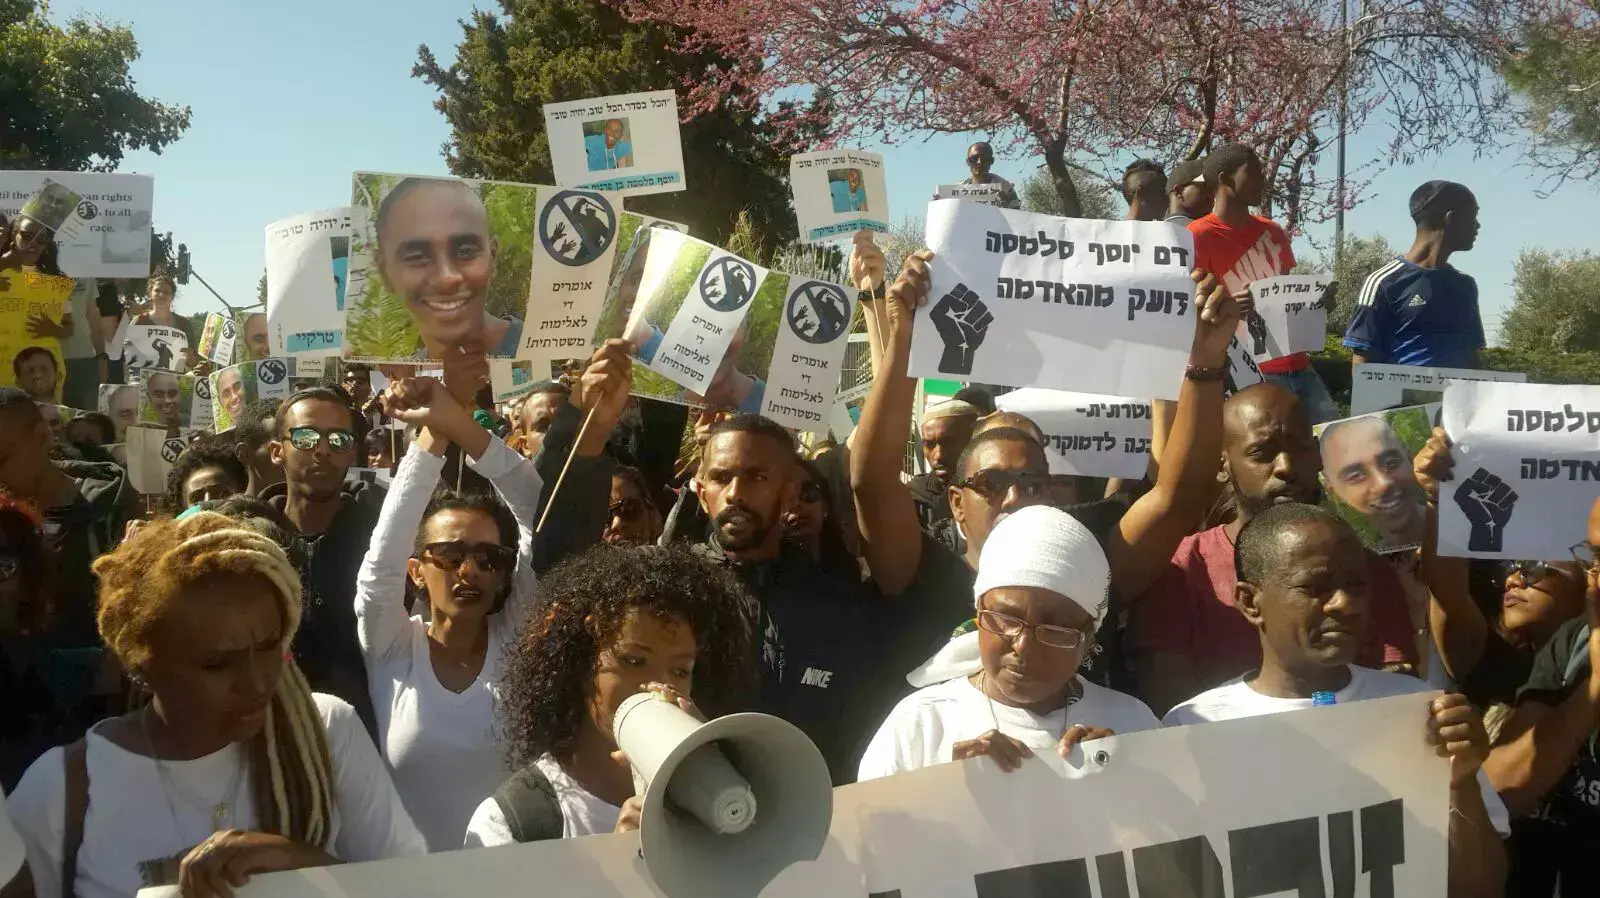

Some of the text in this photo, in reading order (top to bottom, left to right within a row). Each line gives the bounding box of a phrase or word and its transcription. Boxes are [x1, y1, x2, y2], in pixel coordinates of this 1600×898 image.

[12, 191, 31, 200] the
[102, 193, 133, 203] rights
[118, 208, 131, 216] all
[90, 225, 115, 233] race,
[310, 218, 338, 232] יהיה
[986, 230, 1189, 267] דם יוסף סלמסה
[552, 281, 593, 292] אומרים
[1260, 287, 1270, 298] זה
[1271, 281, 1280, 295] לי
[563, 301, 574, 310] די
[997, 277, 1189, 321] זועק מהאדמה
[539, 314, 588, 330] לאלימות
[691, 315, 724, 335] אומרים
[296, 332, 335, 347] טרקיי
[525, 337, 586, 350] משטרתית!
[696, 335, 705, 345] די
[673, 343, 711, 366] לאלימות
[659, 352, 705, 382] משטרתית!
[791, 354, 829, 370] אומרים
[801, 374, 811, 383] די
[780, 387, 824, 404] לאלימות
[767, 400, 822, 422] משטרתית!
[1507, 403, 1600, 434] סלמסה
[801, 667, 834, 688] NIKE
